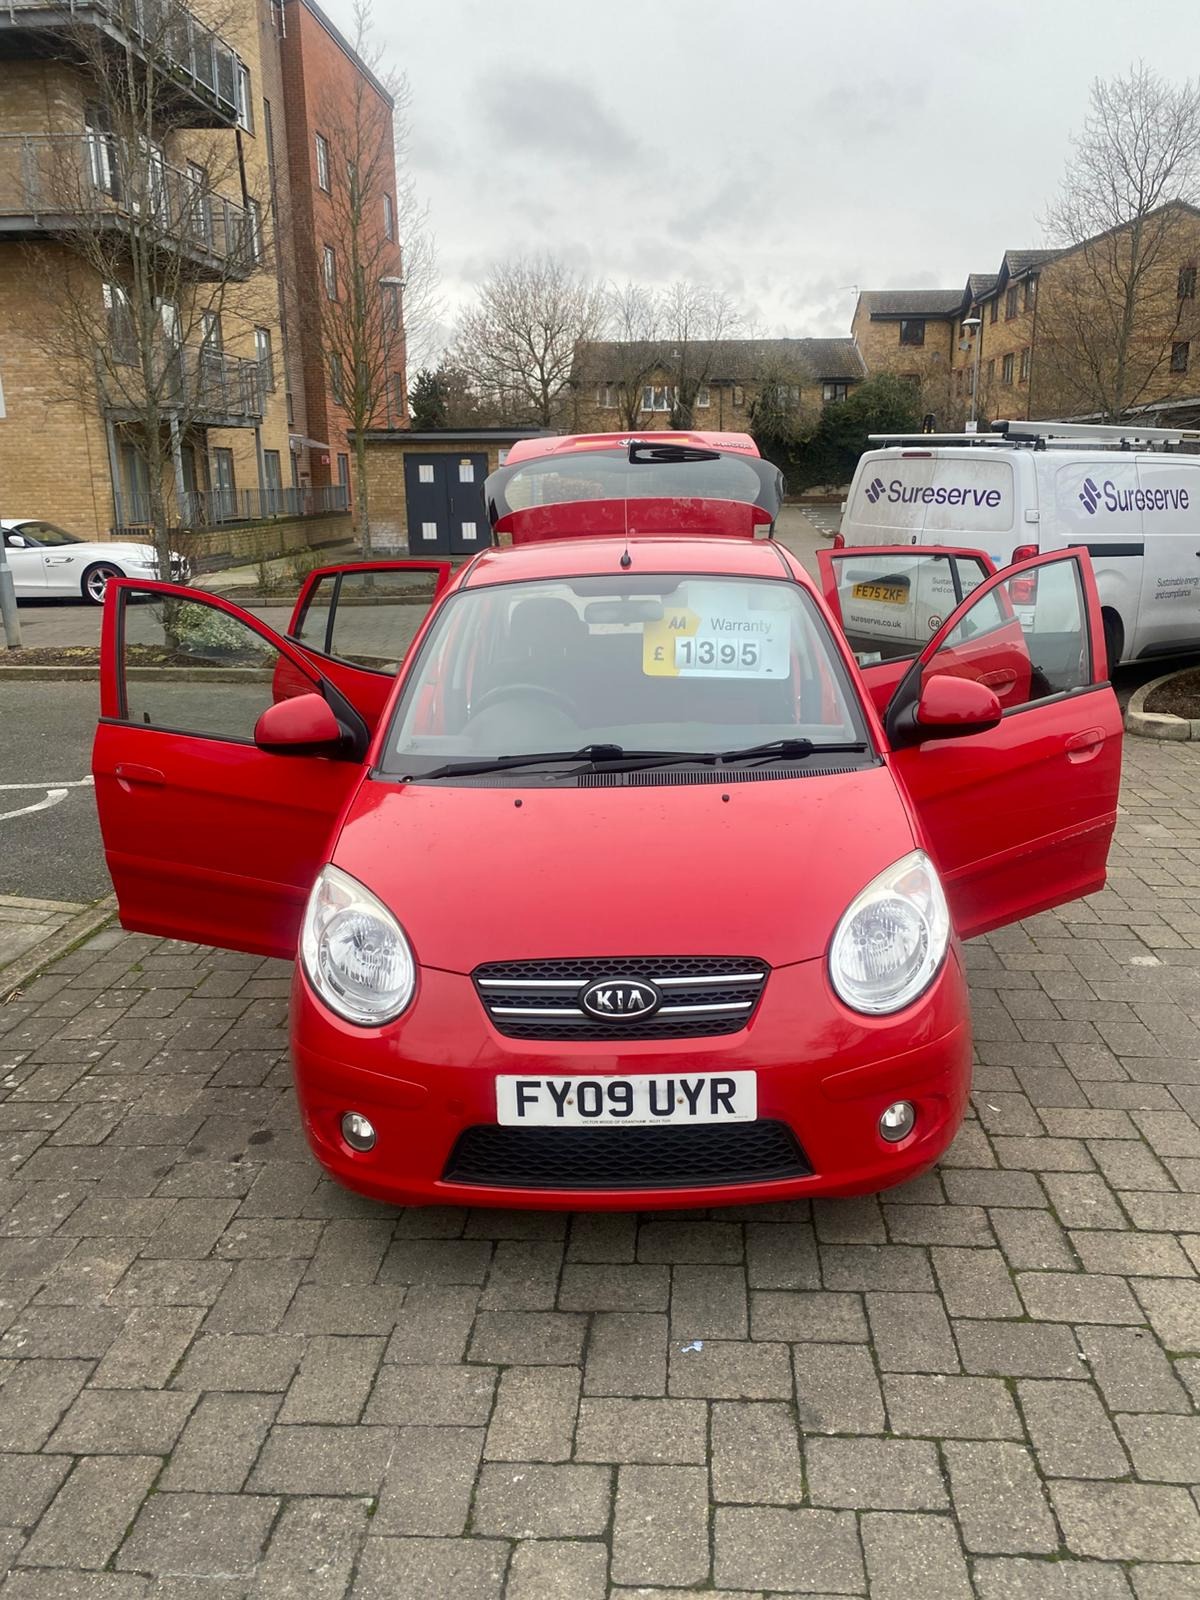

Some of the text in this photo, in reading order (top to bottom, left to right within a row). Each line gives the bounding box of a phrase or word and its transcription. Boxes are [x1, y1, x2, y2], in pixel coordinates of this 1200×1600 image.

[888, 479, 1001, 508] Sureserve
[1103, 480, 1189, 512] Sureserve
[855, 585, 904, 601] FE75 ZKF
[668, 616, 773, 634] AA Warranty
[851, 615, 902, 628] sureserve.co.uk
[654, 640, 759, 666] £ 1395
[595, 989, 646, 1010] KIA
[515, 1077, 737, 1118] FY09 UYR
